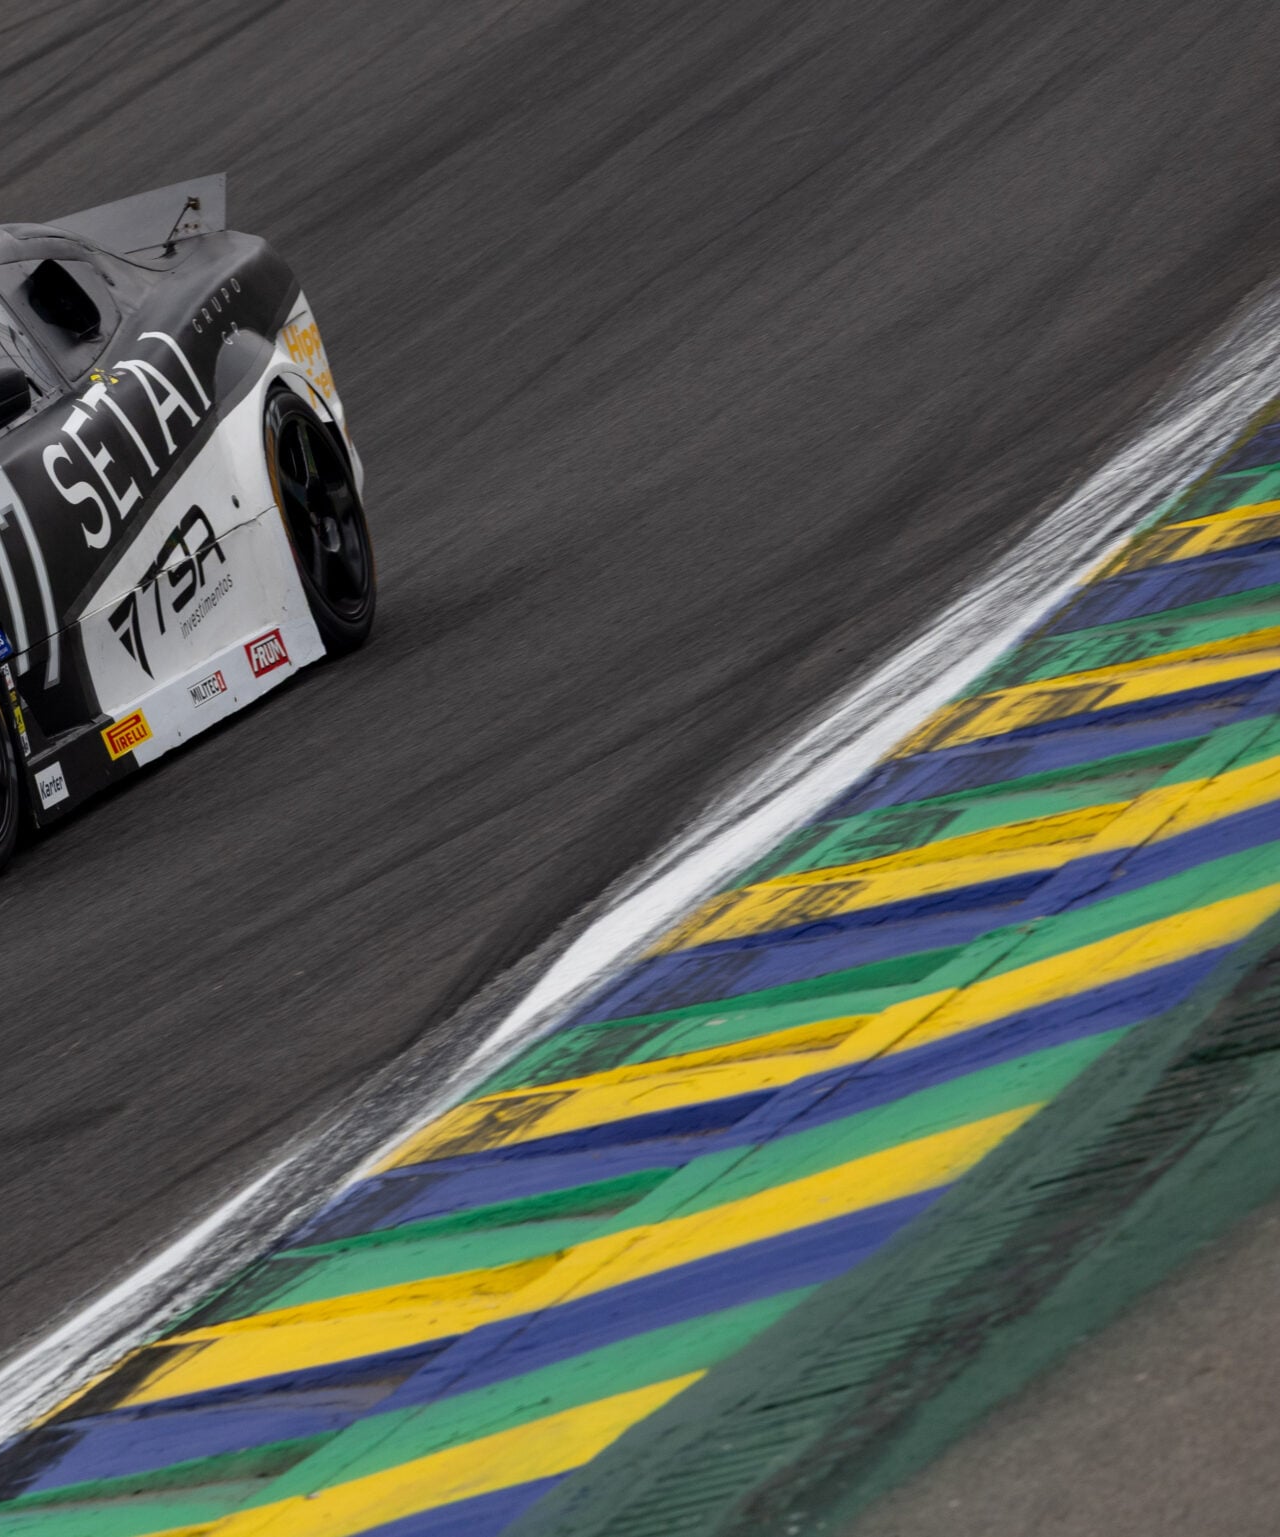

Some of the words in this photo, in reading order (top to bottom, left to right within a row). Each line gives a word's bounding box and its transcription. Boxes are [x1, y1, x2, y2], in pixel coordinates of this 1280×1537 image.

[192, 278, 241, 334] GRUPO
[42, 331, 211, 549] SETAI
[179, 573, 234, 640] investimentos
[250, 634, 288, 673] FRUM
[106, 713, 148, 754] PIRELLI
[39, 775, 64, 801] Karter
